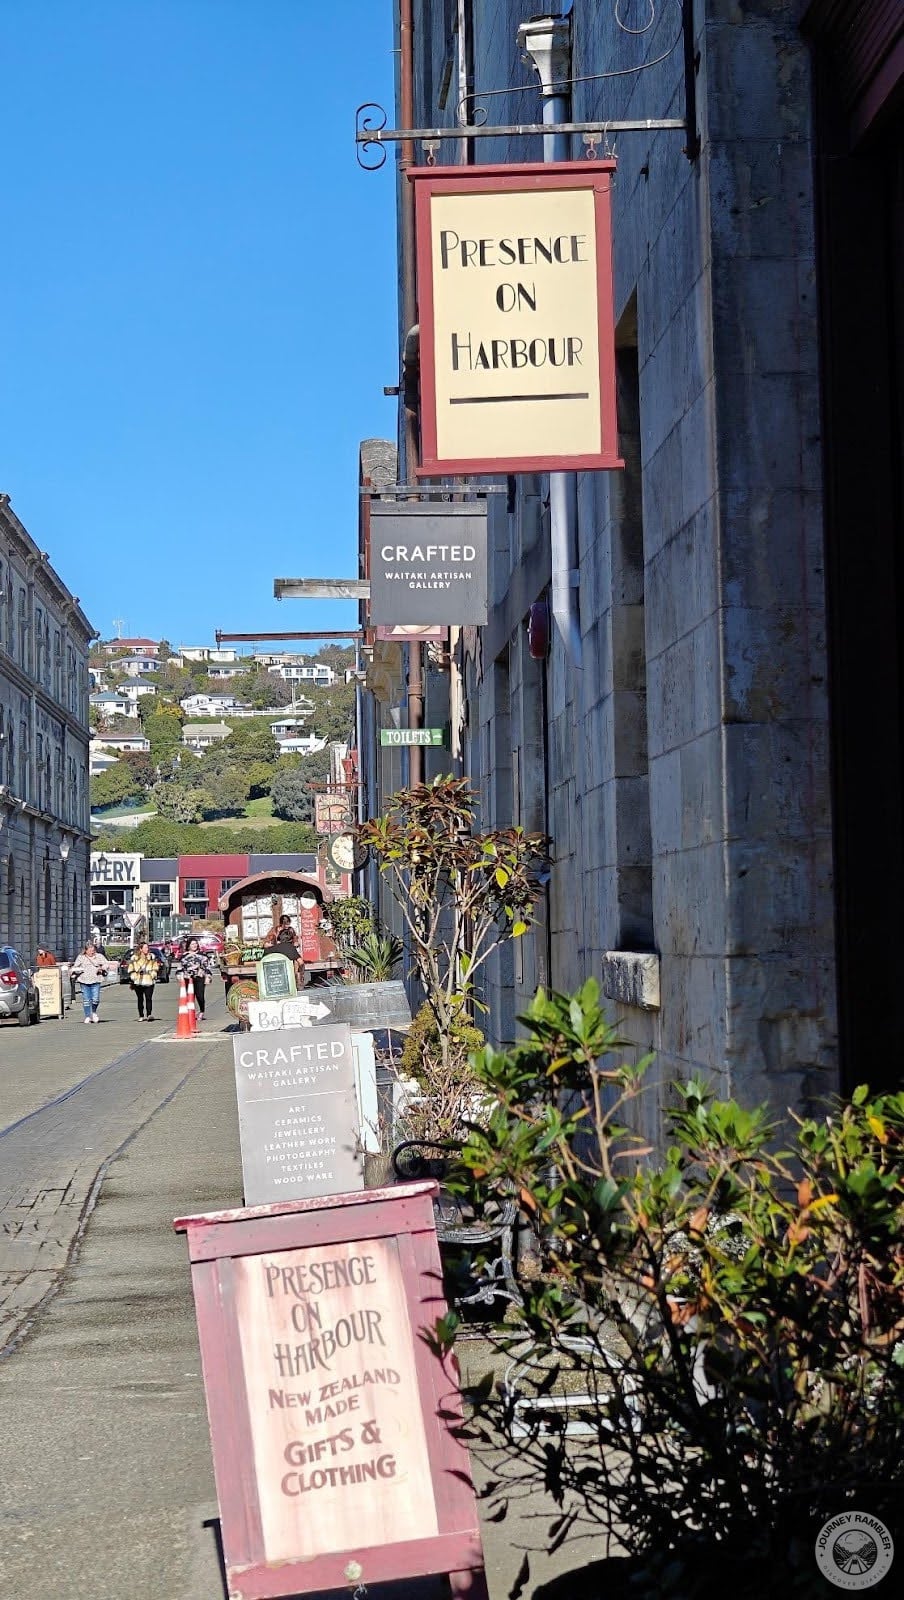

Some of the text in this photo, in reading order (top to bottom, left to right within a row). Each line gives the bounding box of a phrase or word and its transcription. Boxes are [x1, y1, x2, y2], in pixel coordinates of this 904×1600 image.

[440, 230, 589, 269] PRESENCE
[496, 282, 537, 313] ON
[451, 332, 584, 371] HARBOUR
[381, 545, 476, 562] CRAFTED
[385, 572, 427, 580] WAITAKI
[409, 581, 451, 589] GALLERY
[386, 730, 431, 744] TOILETS
[239, 1041, 345, 1068] CRAFTED
[247, 1064, 339, 1080] WAITAKI ARTISAN
[273, 1076, 317, 1088] GALLERY
[289, 1105, 306, 1113] ART
[274, 1115, 322, 1127] CERAMICS
[273, 1127, 326, 1138] JEWELLERY
[264, 1137, 337, 1151] LEATHER WORK
[266, 1148, 337, 1163] PHOTOGRAPHY
[281, 1161, 324, 1172] TEXTILES
[273, 1172, 334, 1185] WOOD WARE
[265, 1256, 377, 1299] PRESENCE
[291, 1301, 323, 1334] ON
[274, 1310, 386, 1377] HARBOUR
[268, 1368, 401, 1410] NEW ZEALAND
[305, 1394, 361, 1427] MADE
[283, 1420, 382, 1467] GIFTS &
[280, 1454, 397, 1497] CLOTHING
